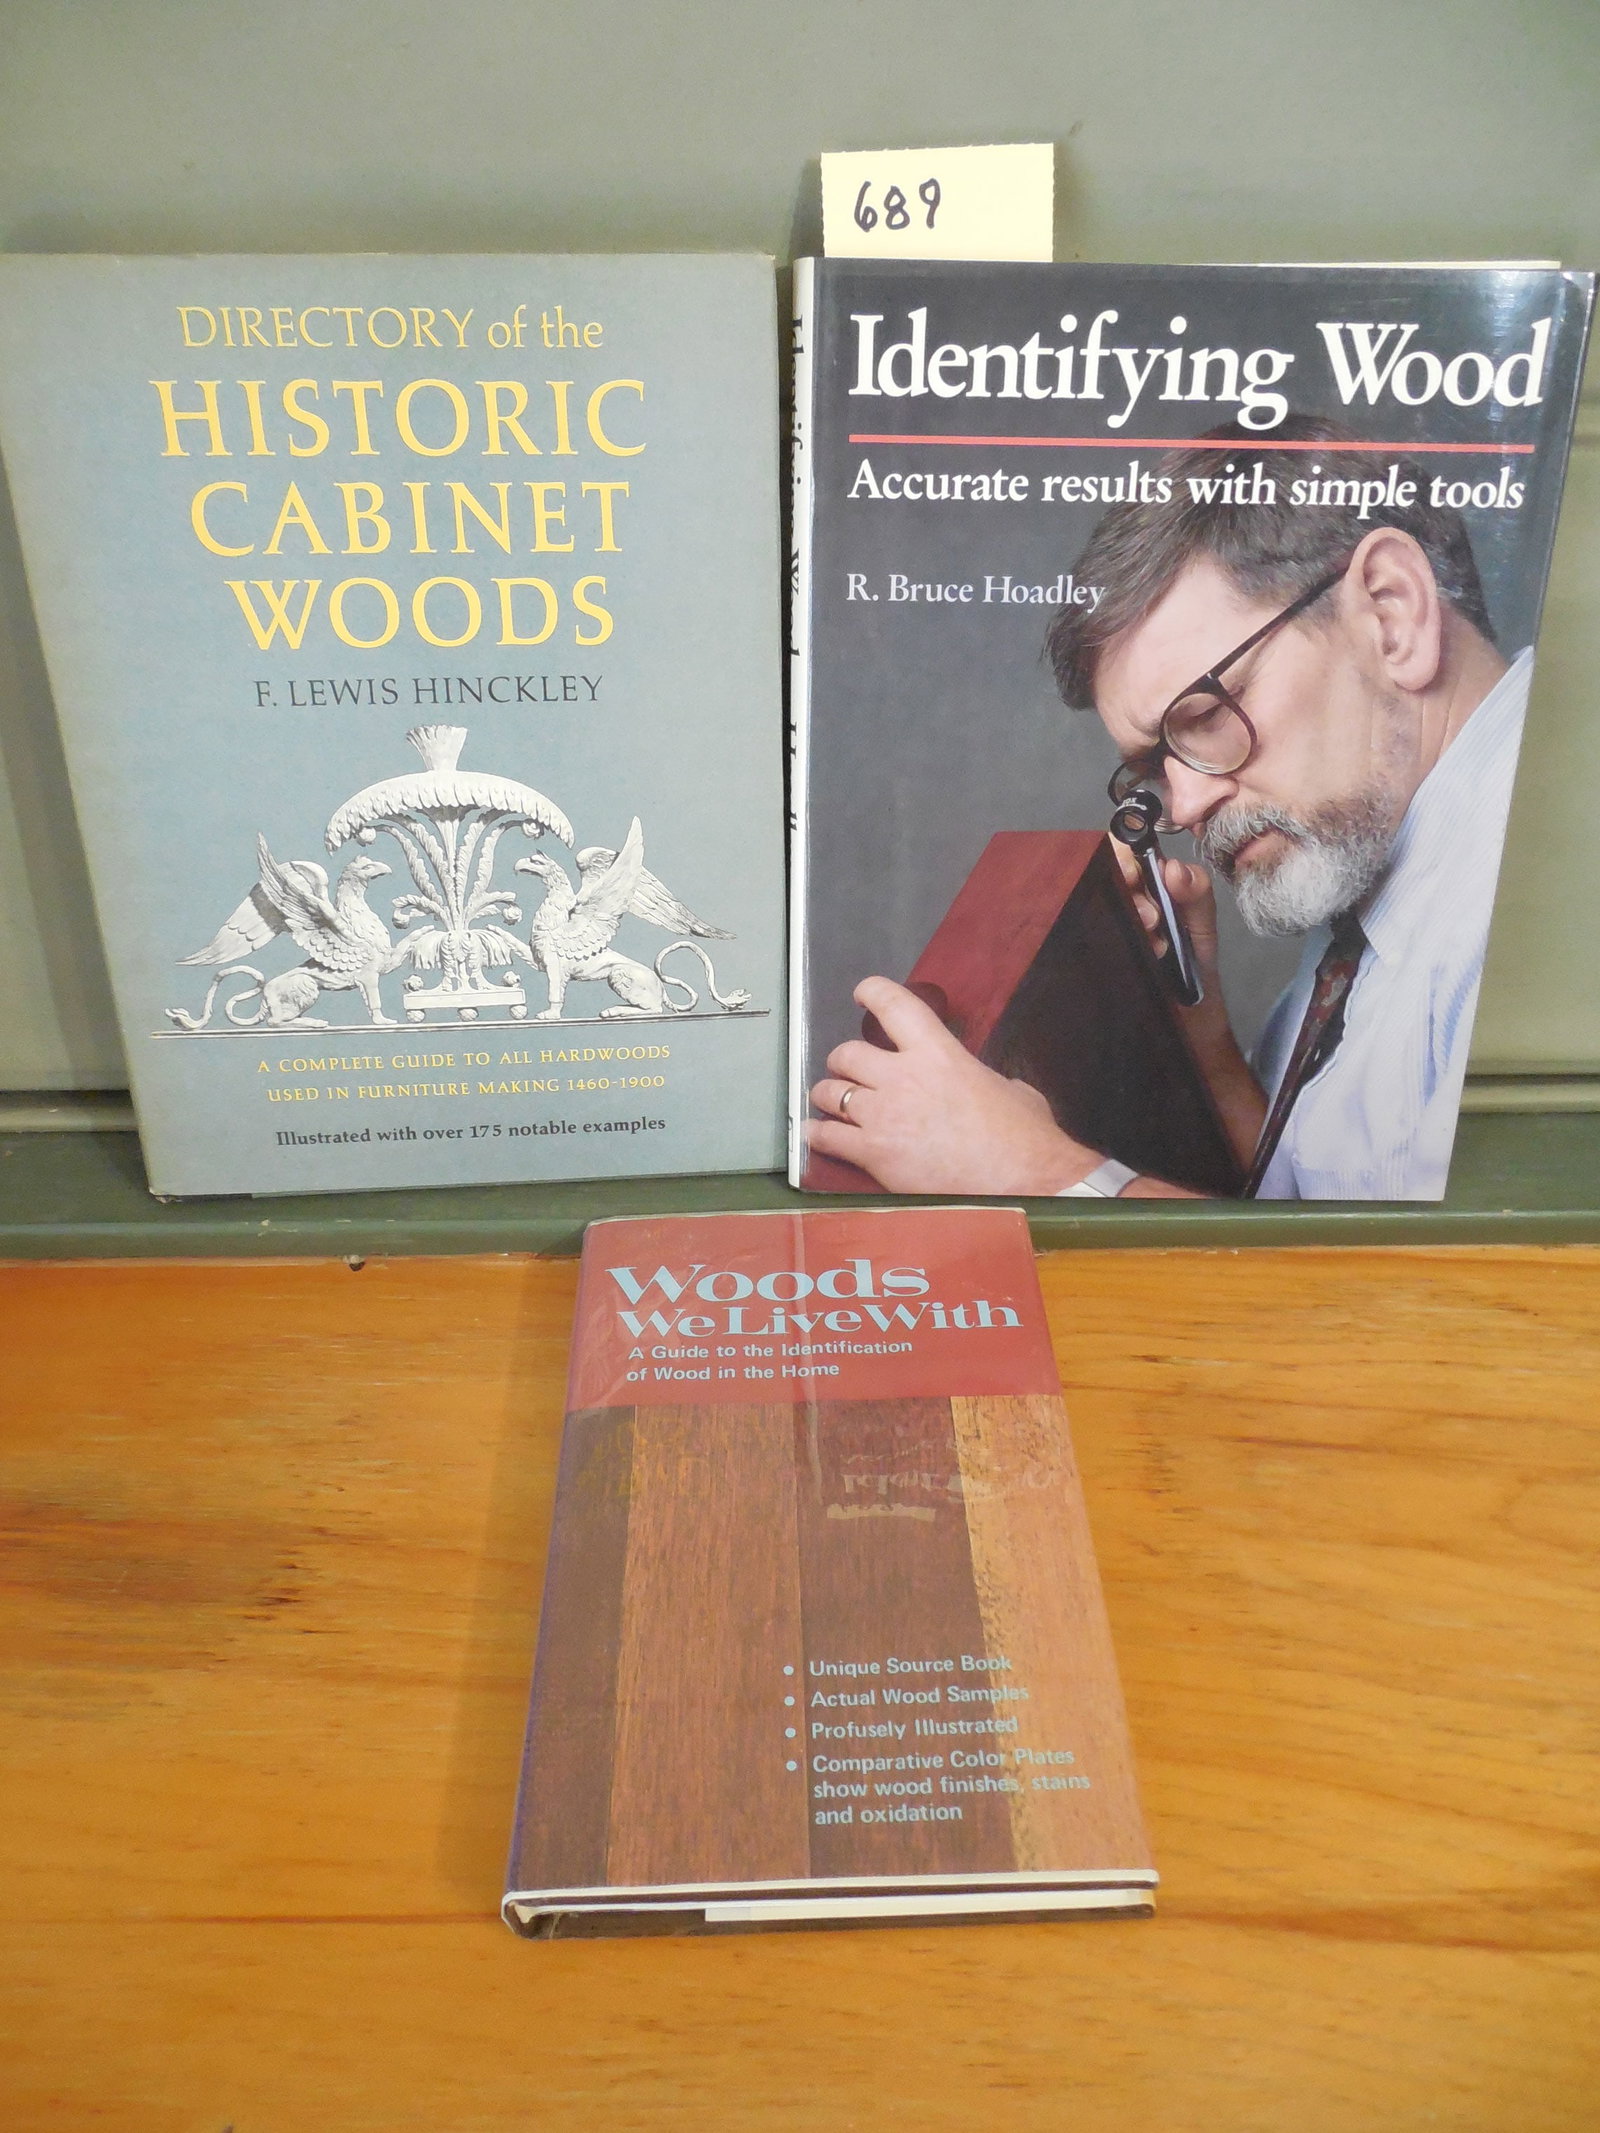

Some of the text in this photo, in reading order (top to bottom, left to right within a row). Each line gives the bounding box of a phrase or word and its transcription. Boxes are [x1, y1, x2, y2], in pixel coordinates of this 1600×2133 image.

[853, 178, 941, 233] 689
[177, 304, 603, 349] DIRECTORY of the
[848, 307, 1552, 430] Identifying Wood
[149, 378, 647, 457] HISTORIC
[847, 459, 1524, 520] Accurate results with simple tools
[190, 480, 630, 558] CABINET
[846, 574, 1105, 614] R. Bruce Hoadley
[224, 575, 615, 650] WOODS
[253, 675, 604, 708] F. LEWIS HINCKLEY
[257, 1044, 671, 1073] A COMPLETE GUIDE TO ALL HARDWOODS
[267, 1074, 665, 1103] USED IN FURNITURE MAKING 1460-1900
[275, 1116, 666, 1147] Illustrated with over 175 notable examples
[605, 1259, 930, 1305] Woods
[628, 1340, 913, 1360] A Guide to the Identification
[626, 1363, 840, 1382] of Wood in the Home
[809, 1655, 1012, 1678] Unique Source Book
[810, 1685, 1029, 1708] Actual Wood Samples
[812, 1716, 1018, 1740] Profusely Illustrated
[812, 1748, 1075, 1774] Comparative Color Plates
[814, 1774, 1090, 1798] show wood finishes, stains
[815, 1804, 962, 1825] and oxidation
